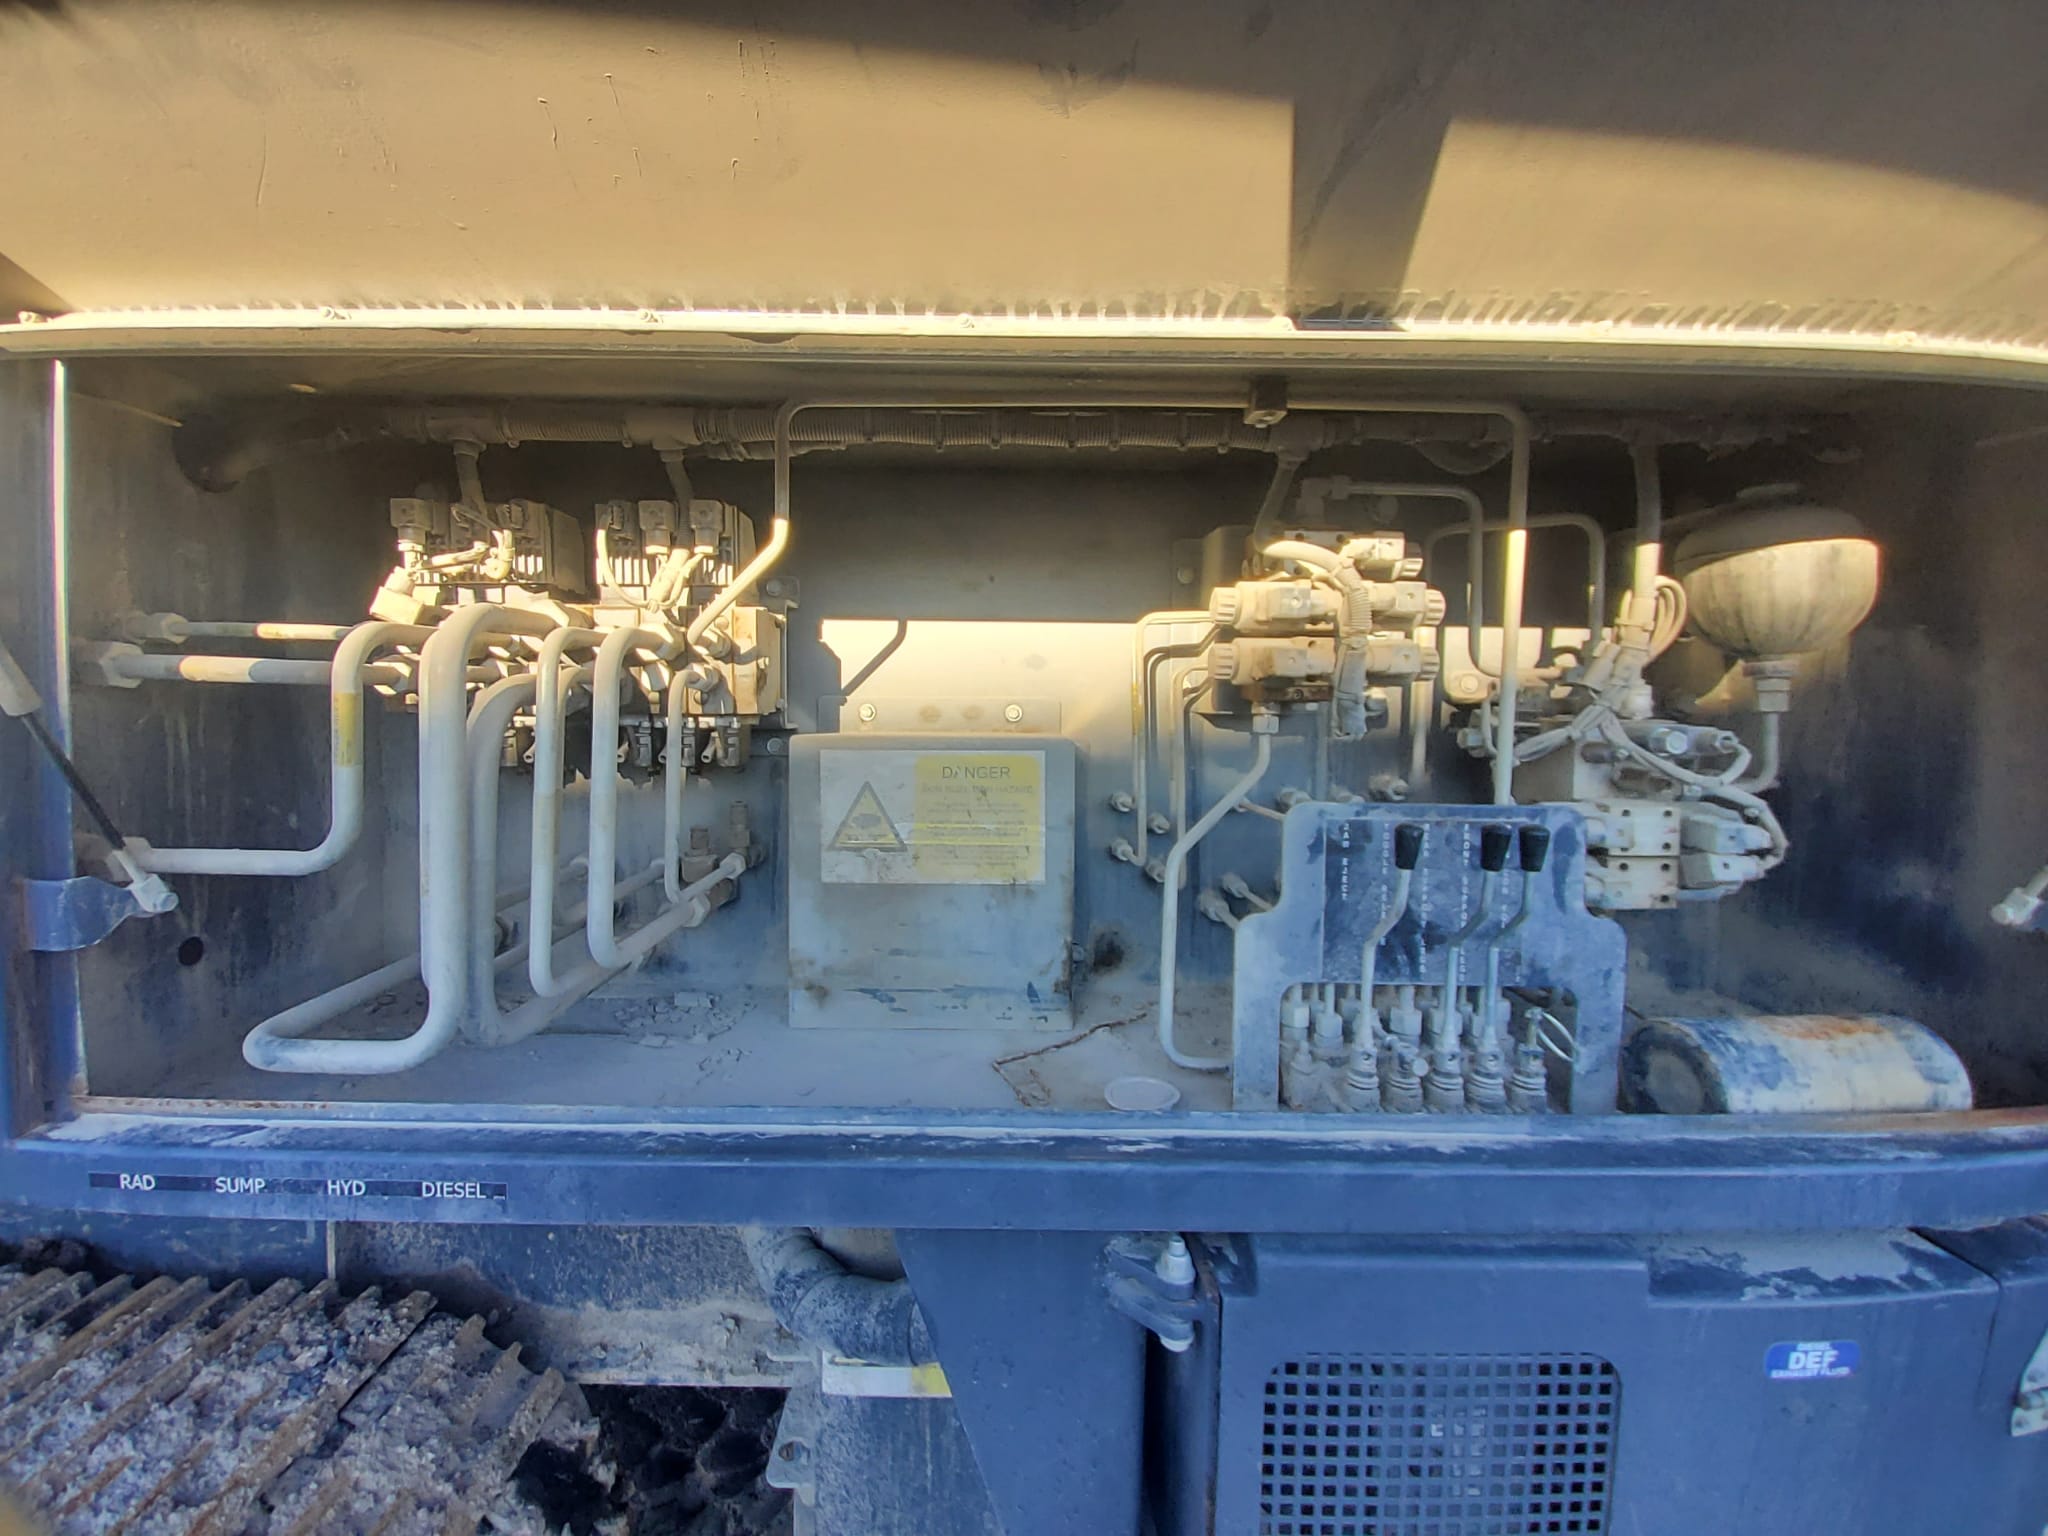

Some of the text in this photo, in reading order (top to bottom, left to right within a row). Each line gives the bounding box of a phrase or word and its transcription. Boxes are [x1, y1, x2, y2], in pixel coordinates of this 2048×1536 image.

[119, 1173, 487, 1200] RAD SUMP HYD DIESEL
[1788, 1350, 1838, 1370] DEF
